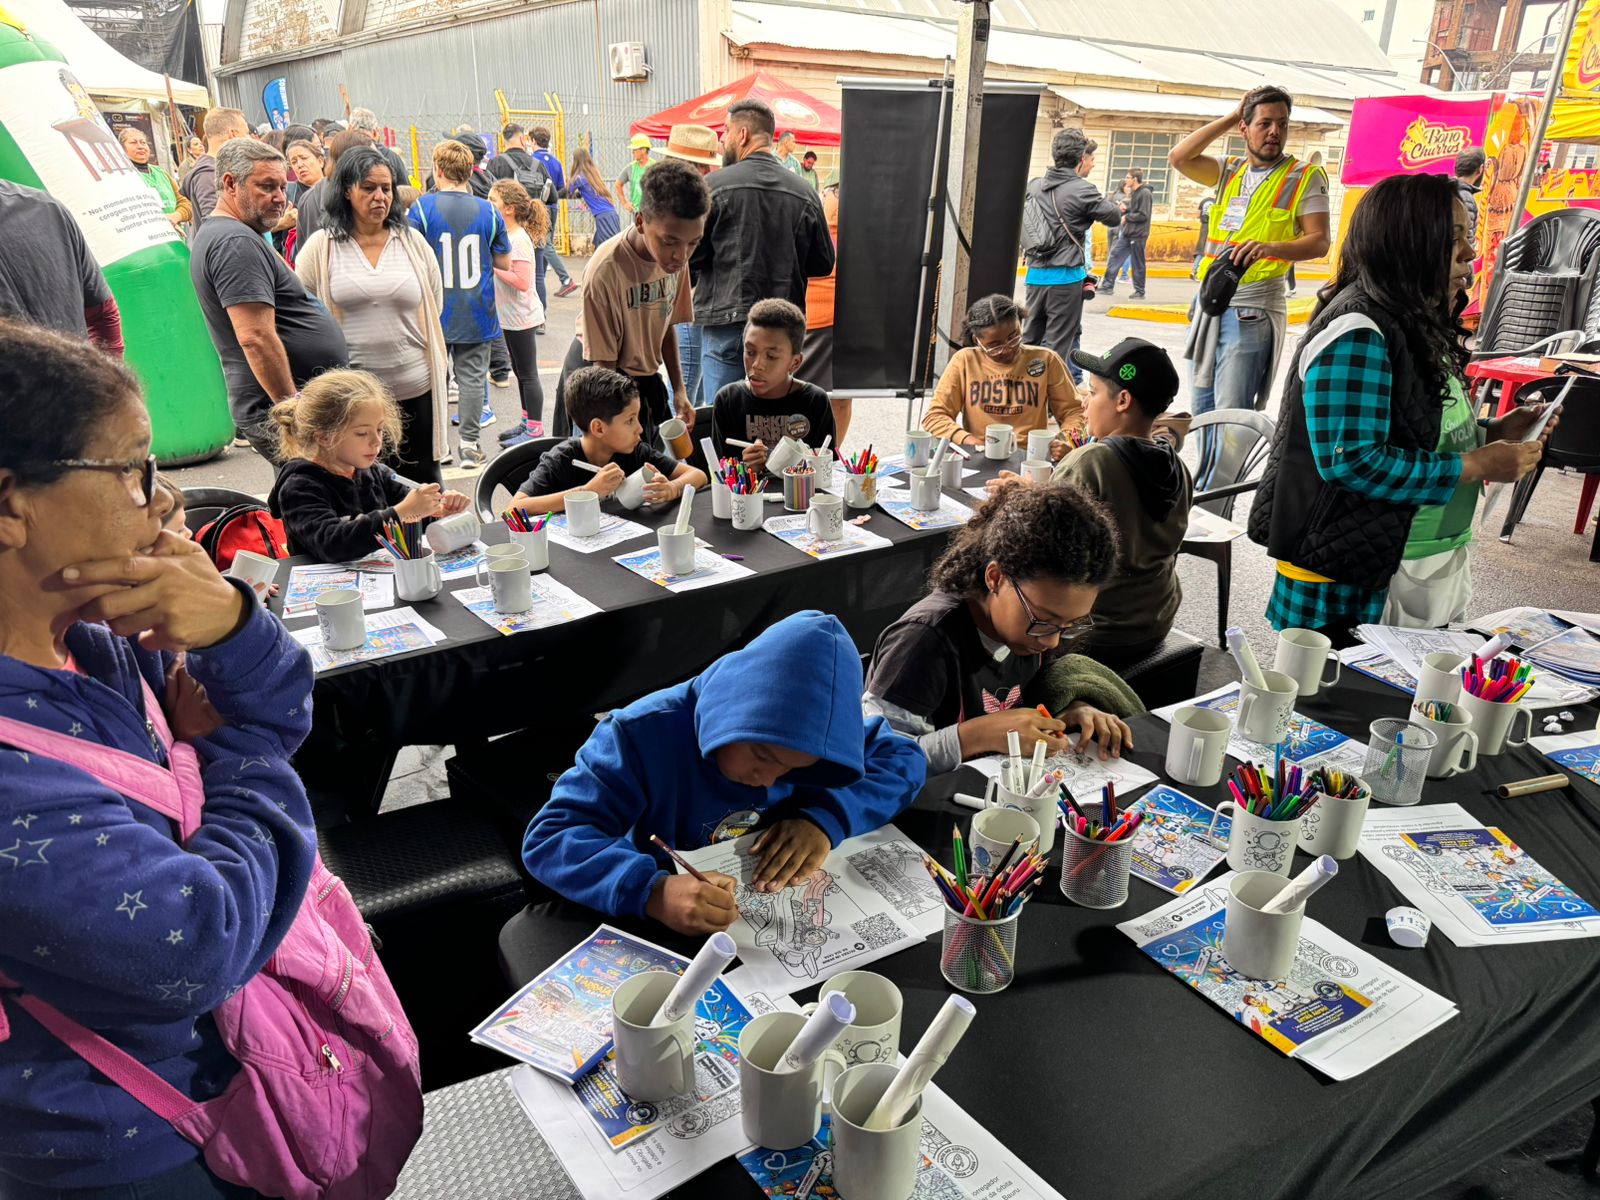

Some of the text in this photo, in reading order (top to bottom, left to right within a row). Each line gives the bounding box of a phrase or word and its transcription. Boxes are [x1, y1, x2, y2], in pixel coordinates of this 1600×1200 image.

[1424, 128, 1461, 144] Bono
[1411, 142, 1461, 159] Churros
[88, 206, 103, 217] Nos
[99, 207, 128, 222] coragem
[438, 232, 482, 289] 10
[970, 379, 1039, 408] BOSTON
